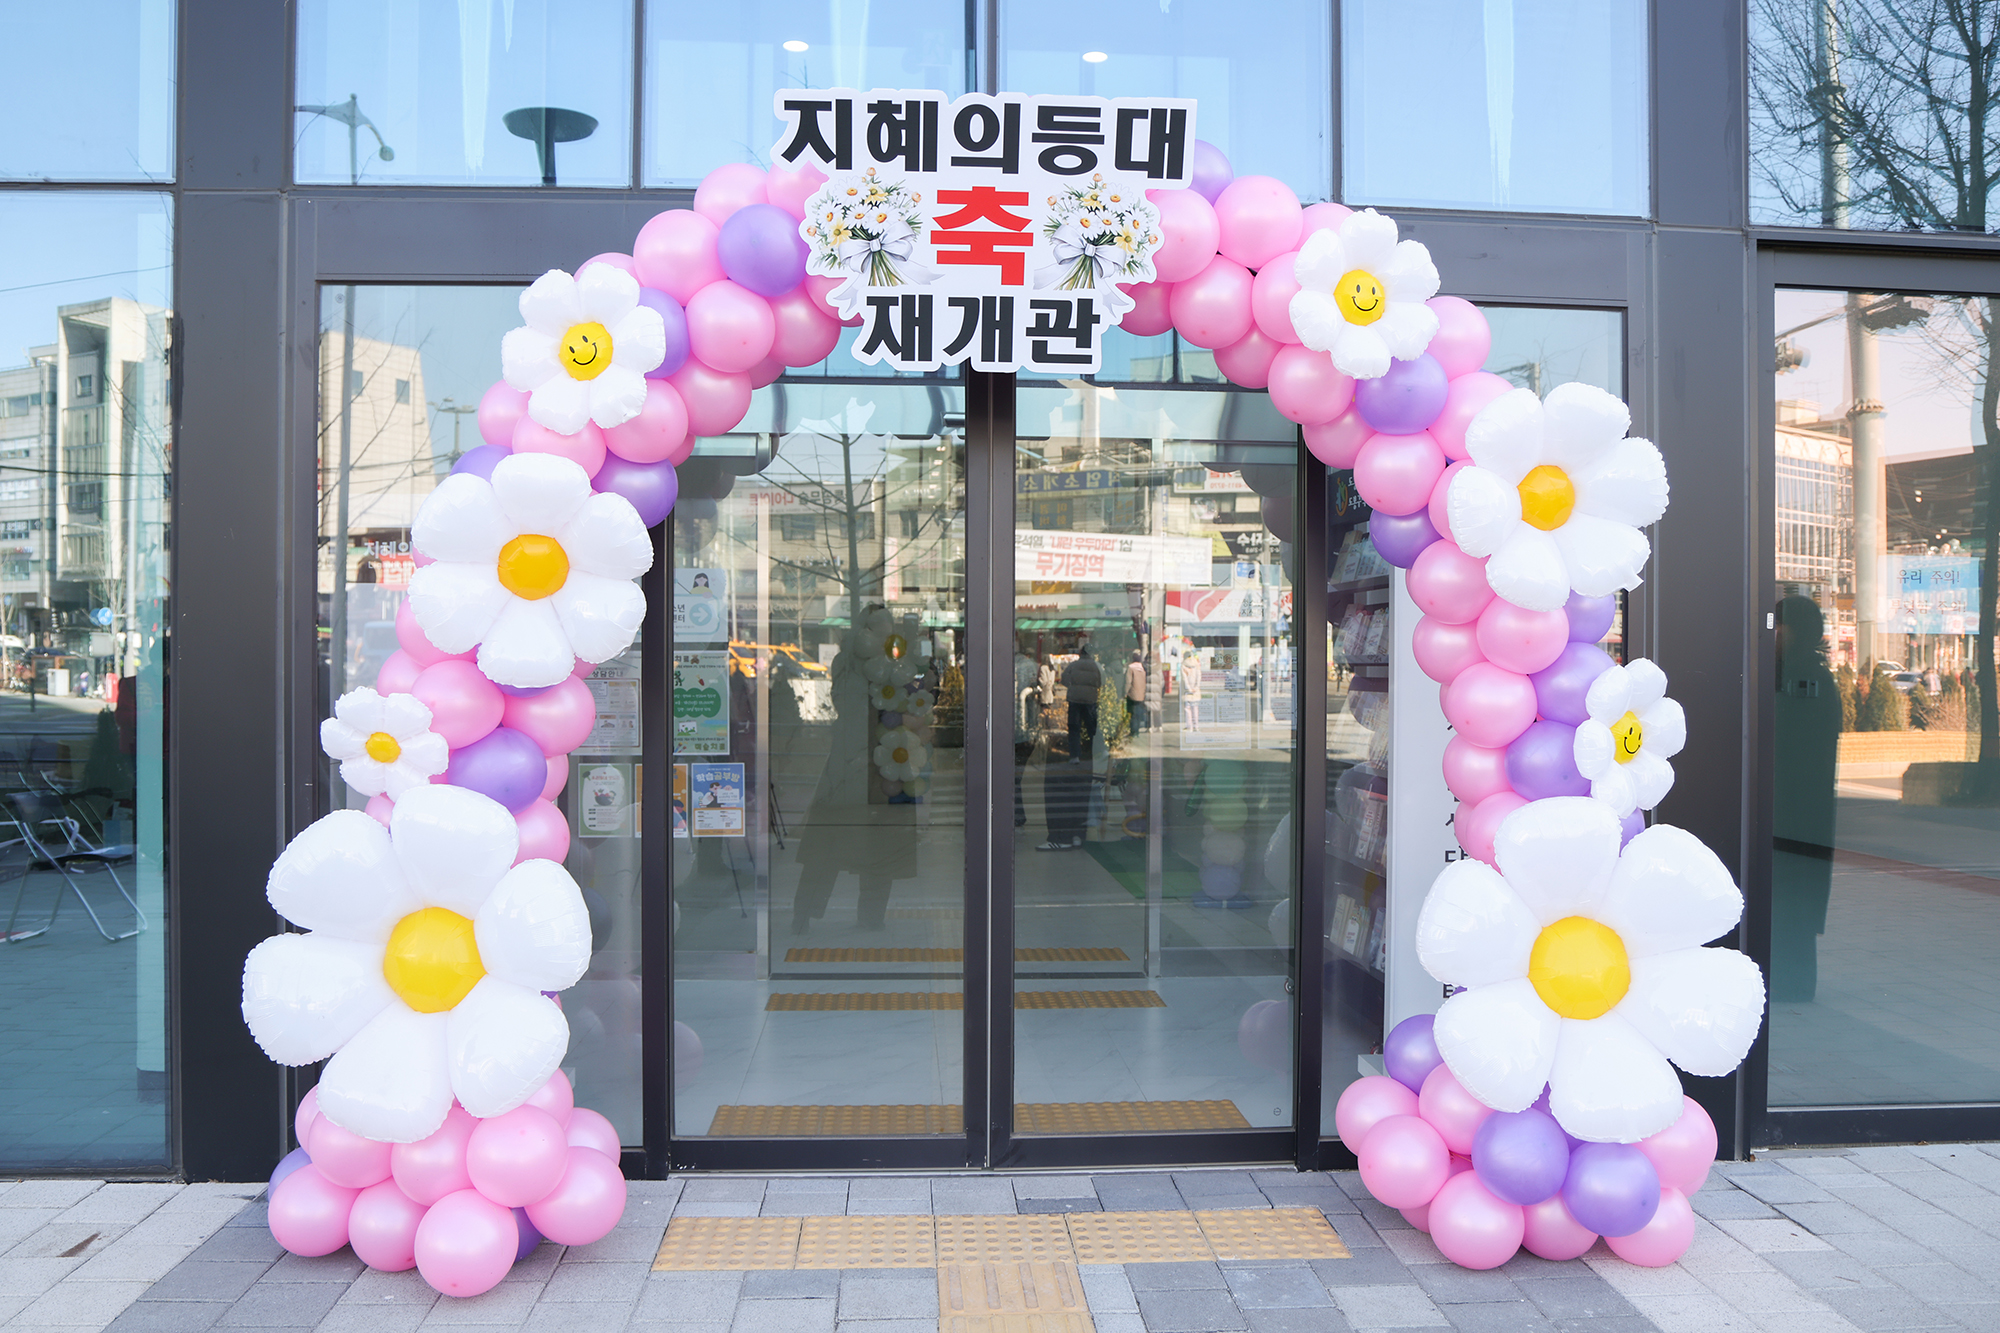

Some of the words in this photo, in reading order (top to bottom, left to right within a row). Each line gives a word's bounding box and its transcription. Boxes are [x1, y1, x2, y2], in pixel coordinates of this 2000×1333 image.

[780, 98, 1187, 180] 지혜의등대
[930, 186, 1034, 286] 축
[861, 294, 1101, 364] 재개관
[1036, 552, 1105, 577] 무기징역
[1896, 569, 1922, 584] 유리
[1930, 569, 1960, 585] 주의!
[1937, 600, 1966, 614] 주의!
